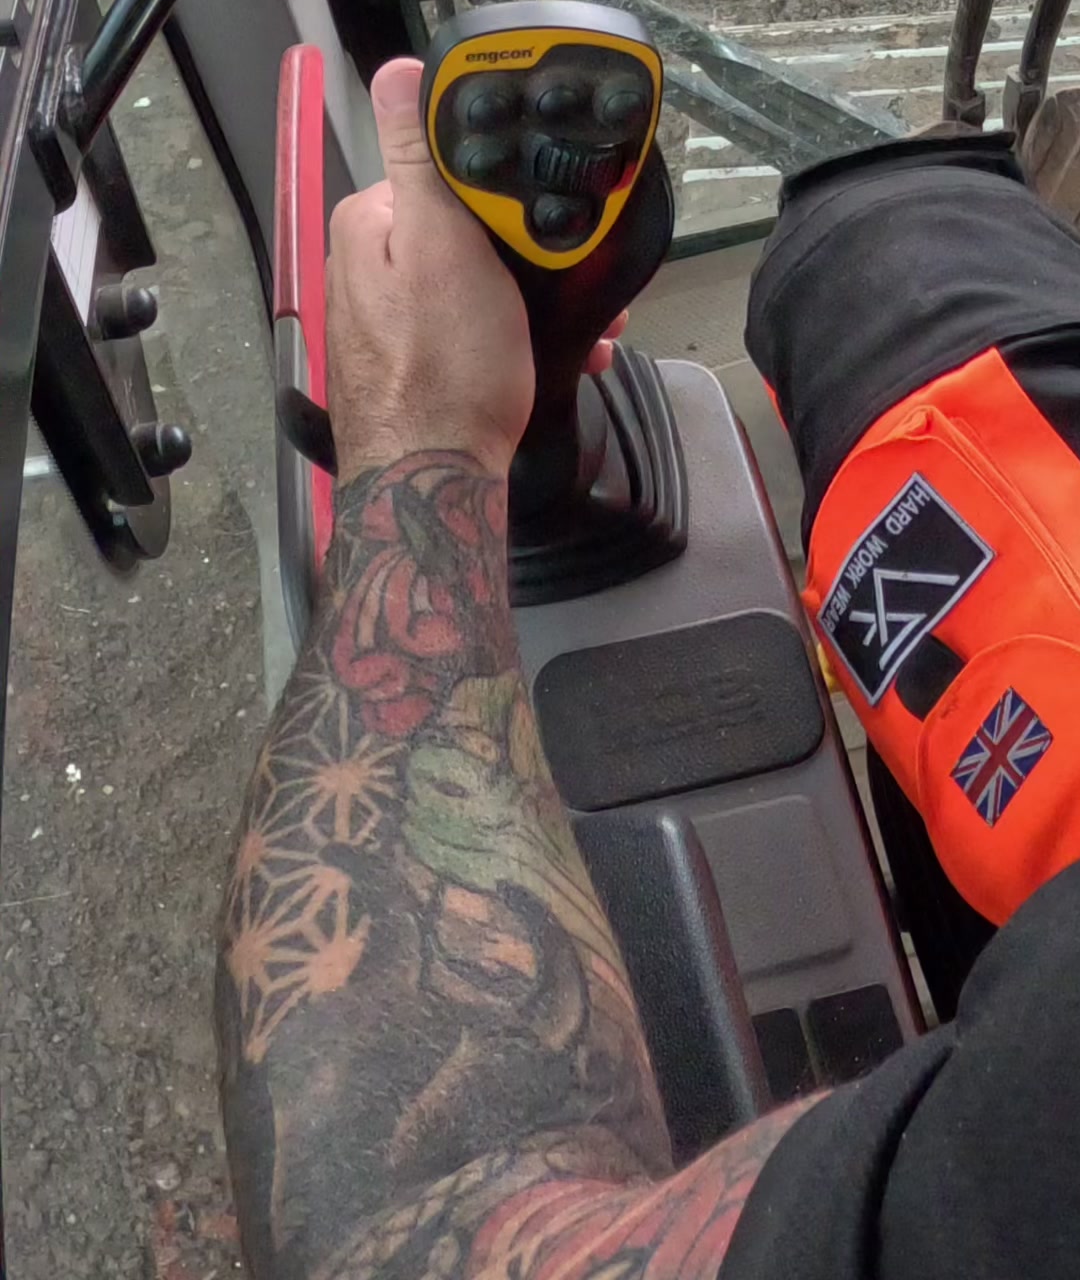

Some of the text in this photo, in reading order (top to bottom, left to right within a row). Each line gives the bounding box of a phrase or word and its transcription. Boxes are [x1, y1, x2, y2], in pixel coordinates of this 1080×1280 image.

[465, 47, 534, 64] engcon
[822, 484, 931, 632] HARD WORK WEAR
